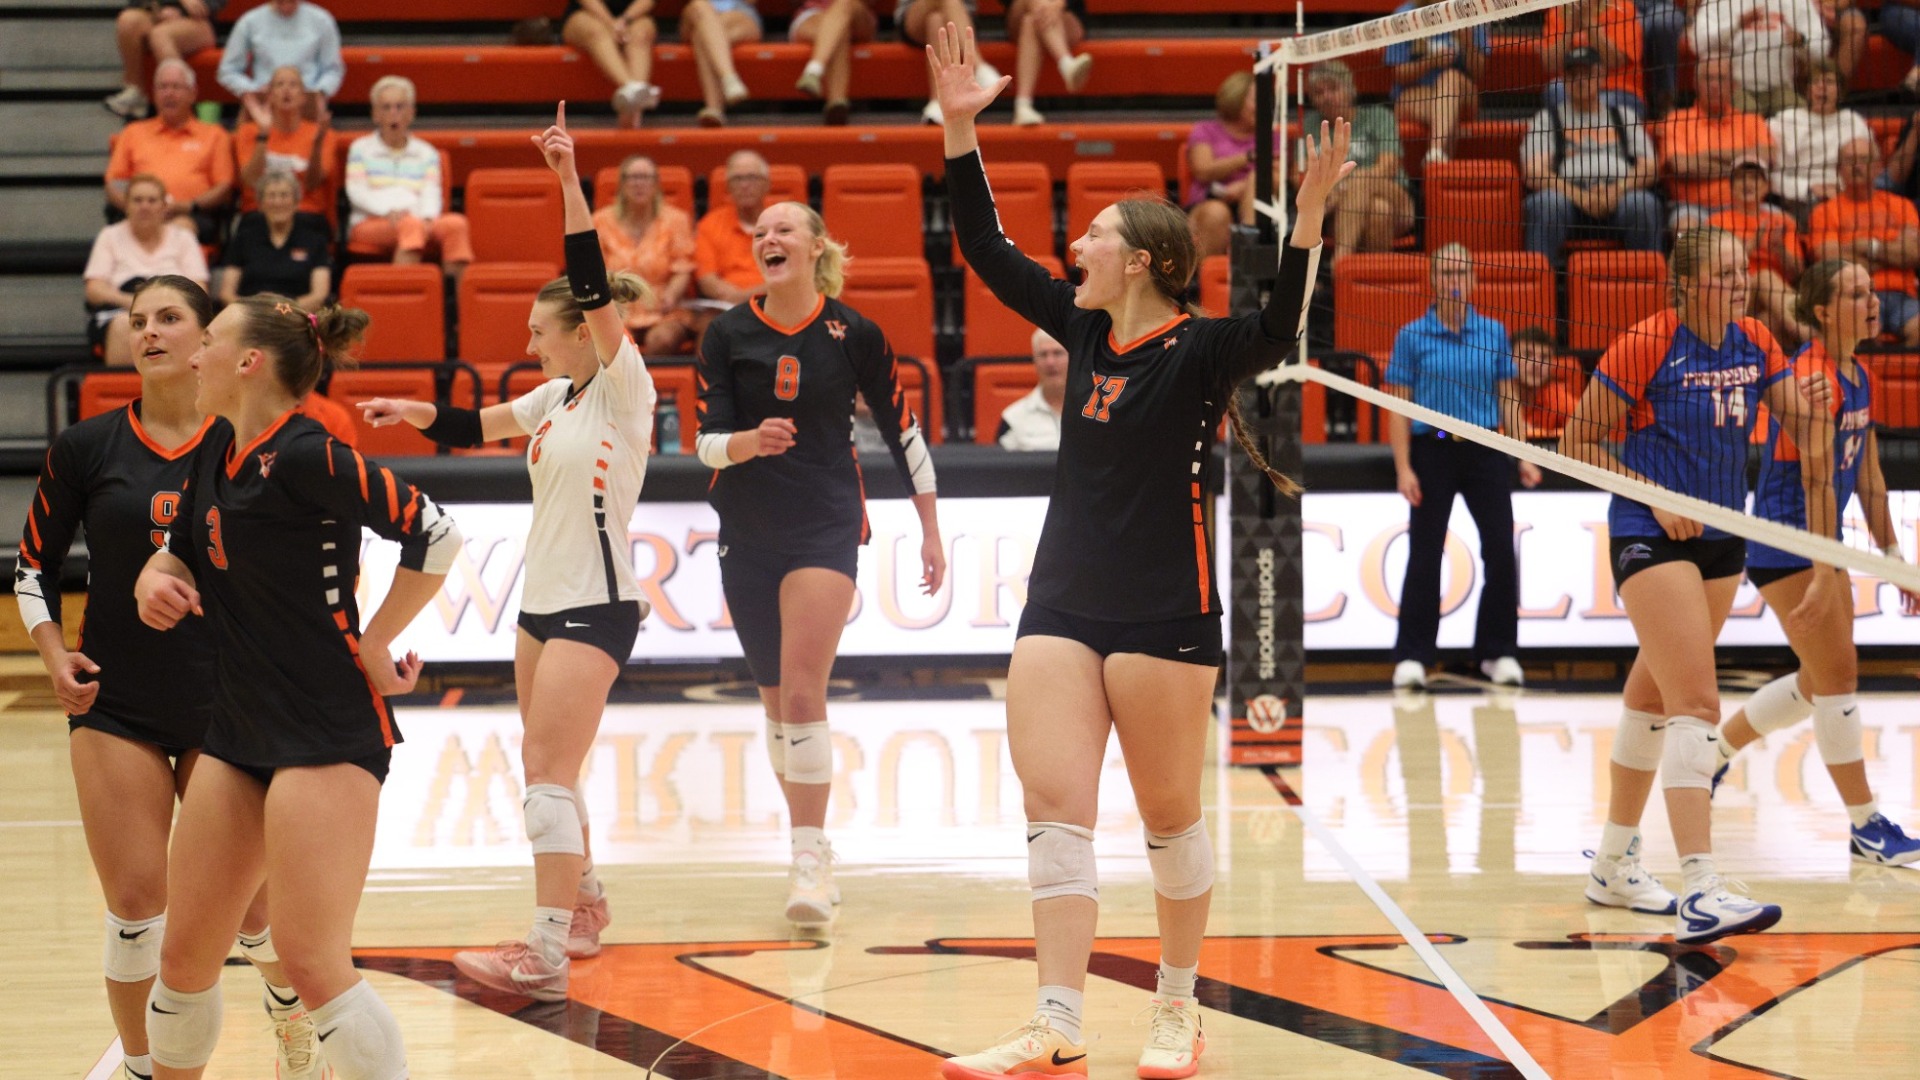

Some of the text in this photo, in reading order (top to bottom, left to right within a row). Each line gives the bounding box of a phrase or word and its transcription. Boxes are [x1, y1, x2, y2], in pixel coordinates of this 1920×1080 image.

[774, 355, 801, 401] 8
[1082, 371, 1129, 423] 17
[1711, 386, 1748, 428] 14
[150, 490, 182, 549] 9
[206, 505, 229, 571] 3
[1256, 547, 1276, 680] sports imports
